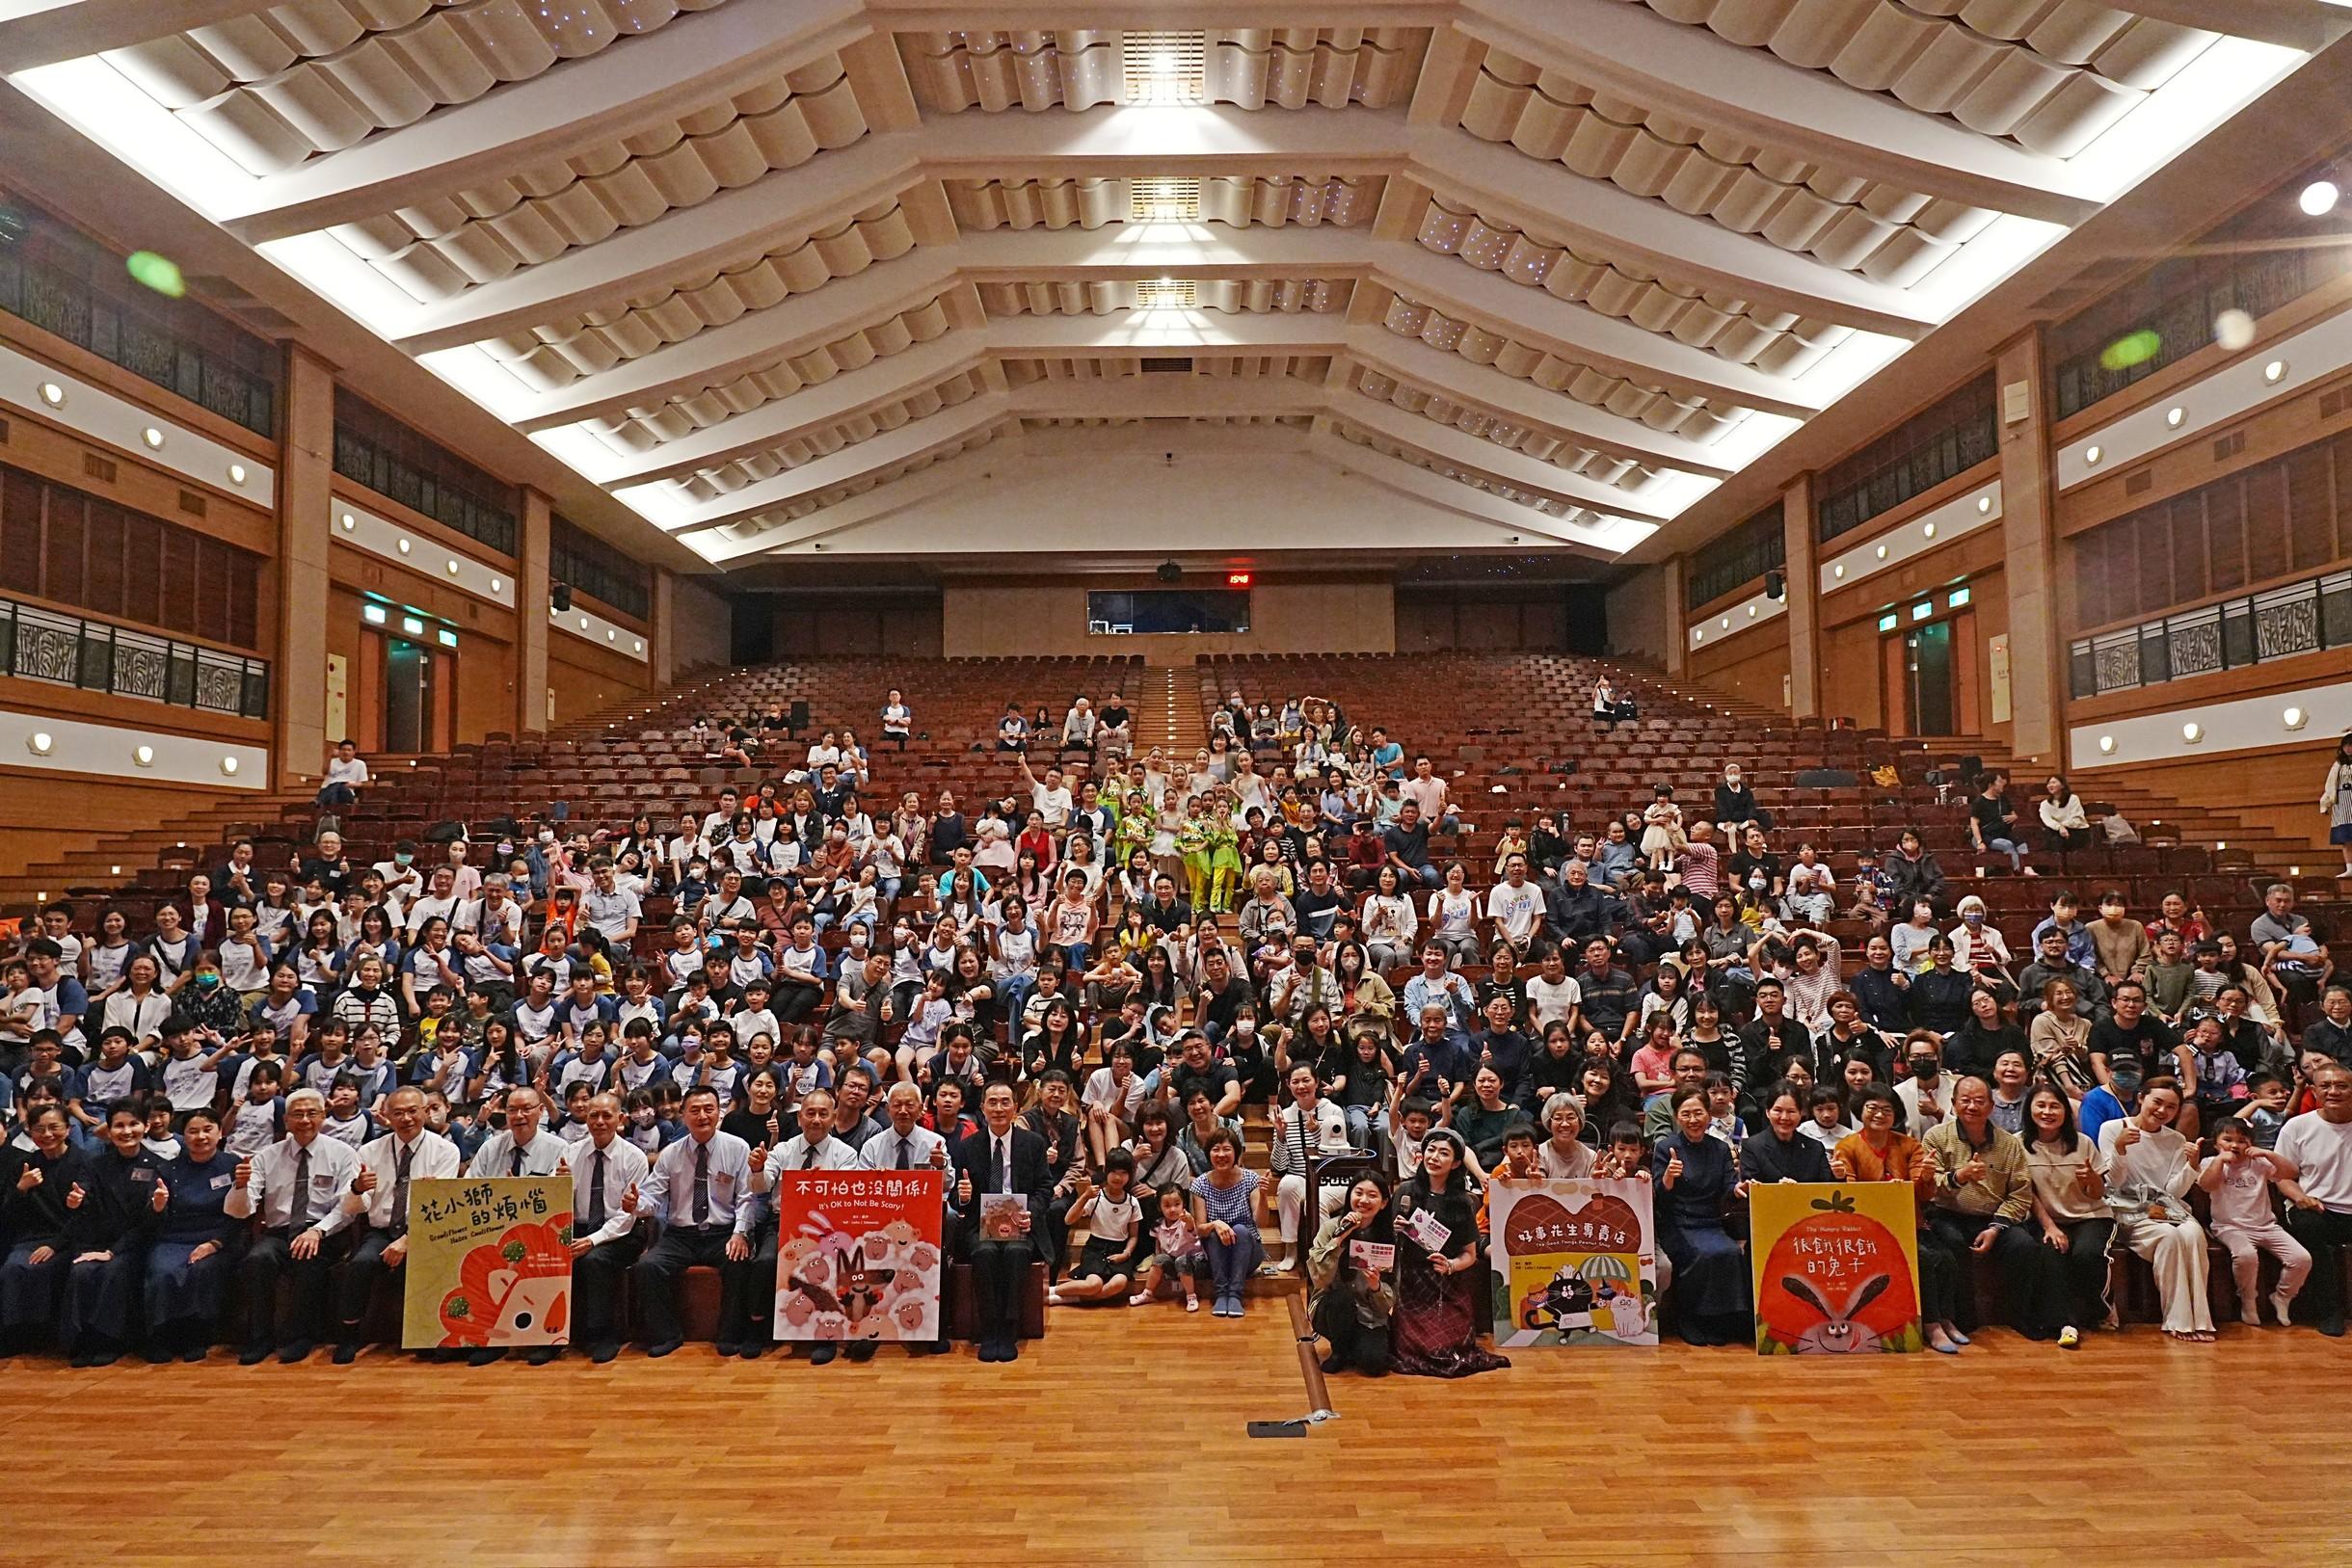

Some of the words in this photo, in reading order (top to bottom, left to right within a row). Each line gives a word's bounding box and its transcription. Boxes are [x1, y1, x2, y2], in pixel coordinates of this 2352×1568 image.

[420, 1183, 494, 1223] 花小獅
[471, 1187, 548, 1226] 的煩惱
[881, 1200, 905, 1210] Scary!
[1518, 1222, 1626, 1245] 好事花生專賣店
[1793, 1236, 1877, 1256] 很餓很餓
[1807, 1256, 1865, 1277] 的兔子
